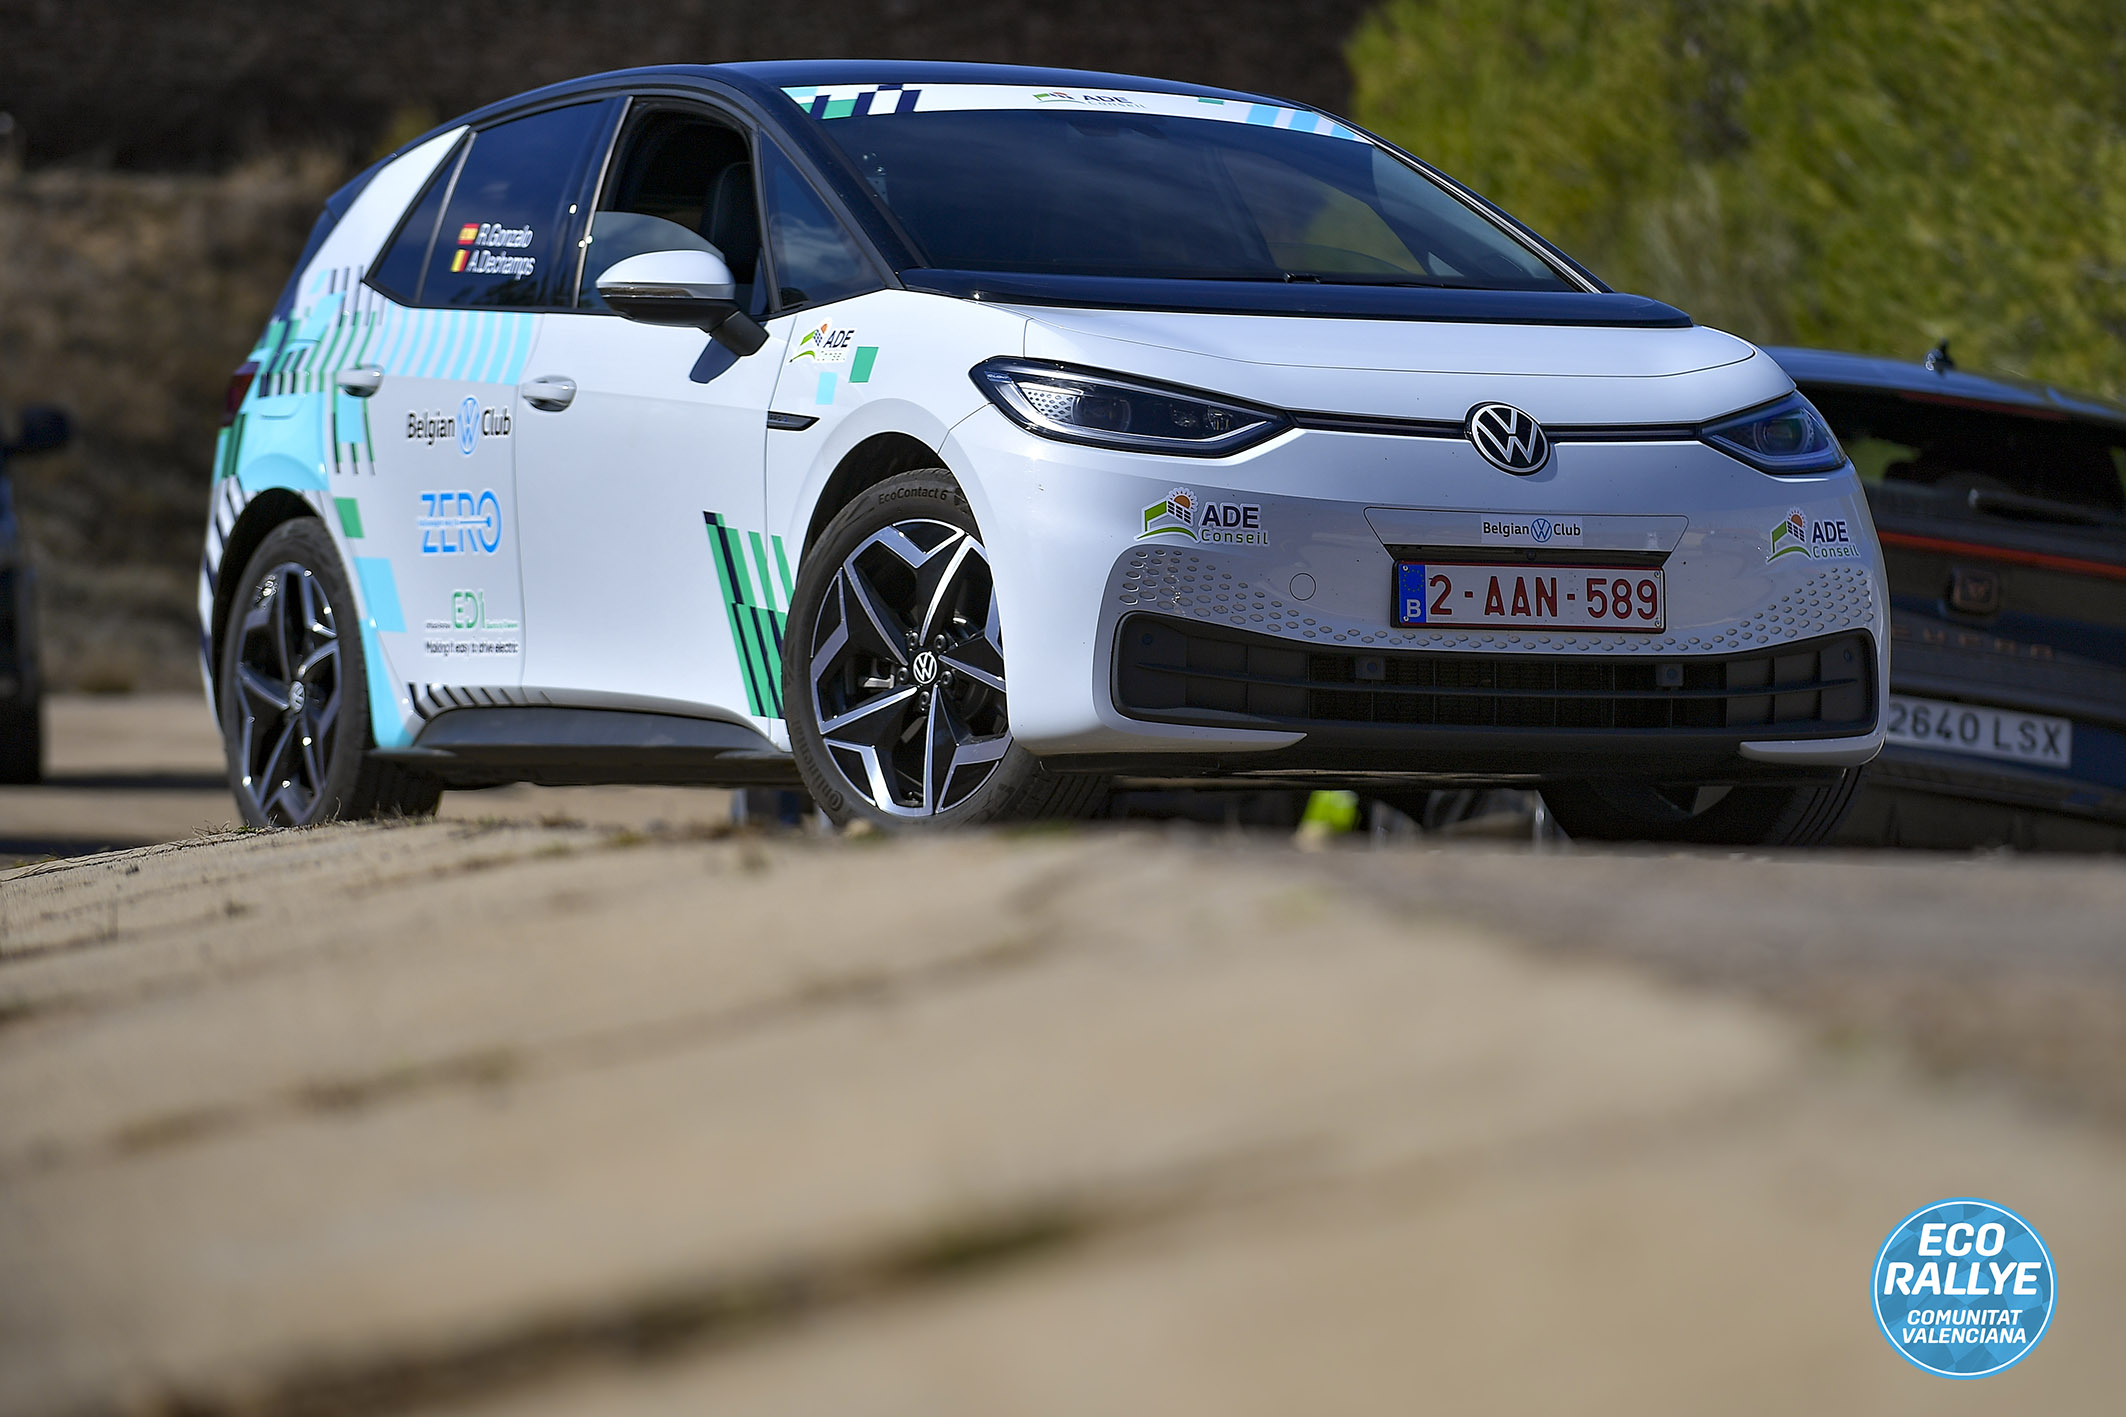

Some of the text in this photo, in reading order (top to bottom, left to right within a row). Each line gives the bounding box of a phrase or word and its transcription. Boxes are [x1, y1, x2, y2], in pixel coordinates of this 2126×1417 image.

[1083, 94, 1133, 104] ADE
[475, 223, 533, 248] R.Gonzalo
[823, 329, 855, 349] ADE
[407, 411, 455, 446] Belgian
[482, 407, 512, 436] Club
[878, 487, 948, 505] EcoContact 6
[421, 491, 502, 553] ZERO
[1201, 504, 1259, 529] ADE
[1201, 529, 1268, 545] Conseil
[1483, 521, 1529, 537] Belgian
[1553, 523, 1581, 537] Club
[1812, 521, 1849, 543] ADE
[1812, 545, 1859, 559] Conseil
[1406, 599, 1422, 618] B
[1888, 702, 2061, 758] 2640 LSX
